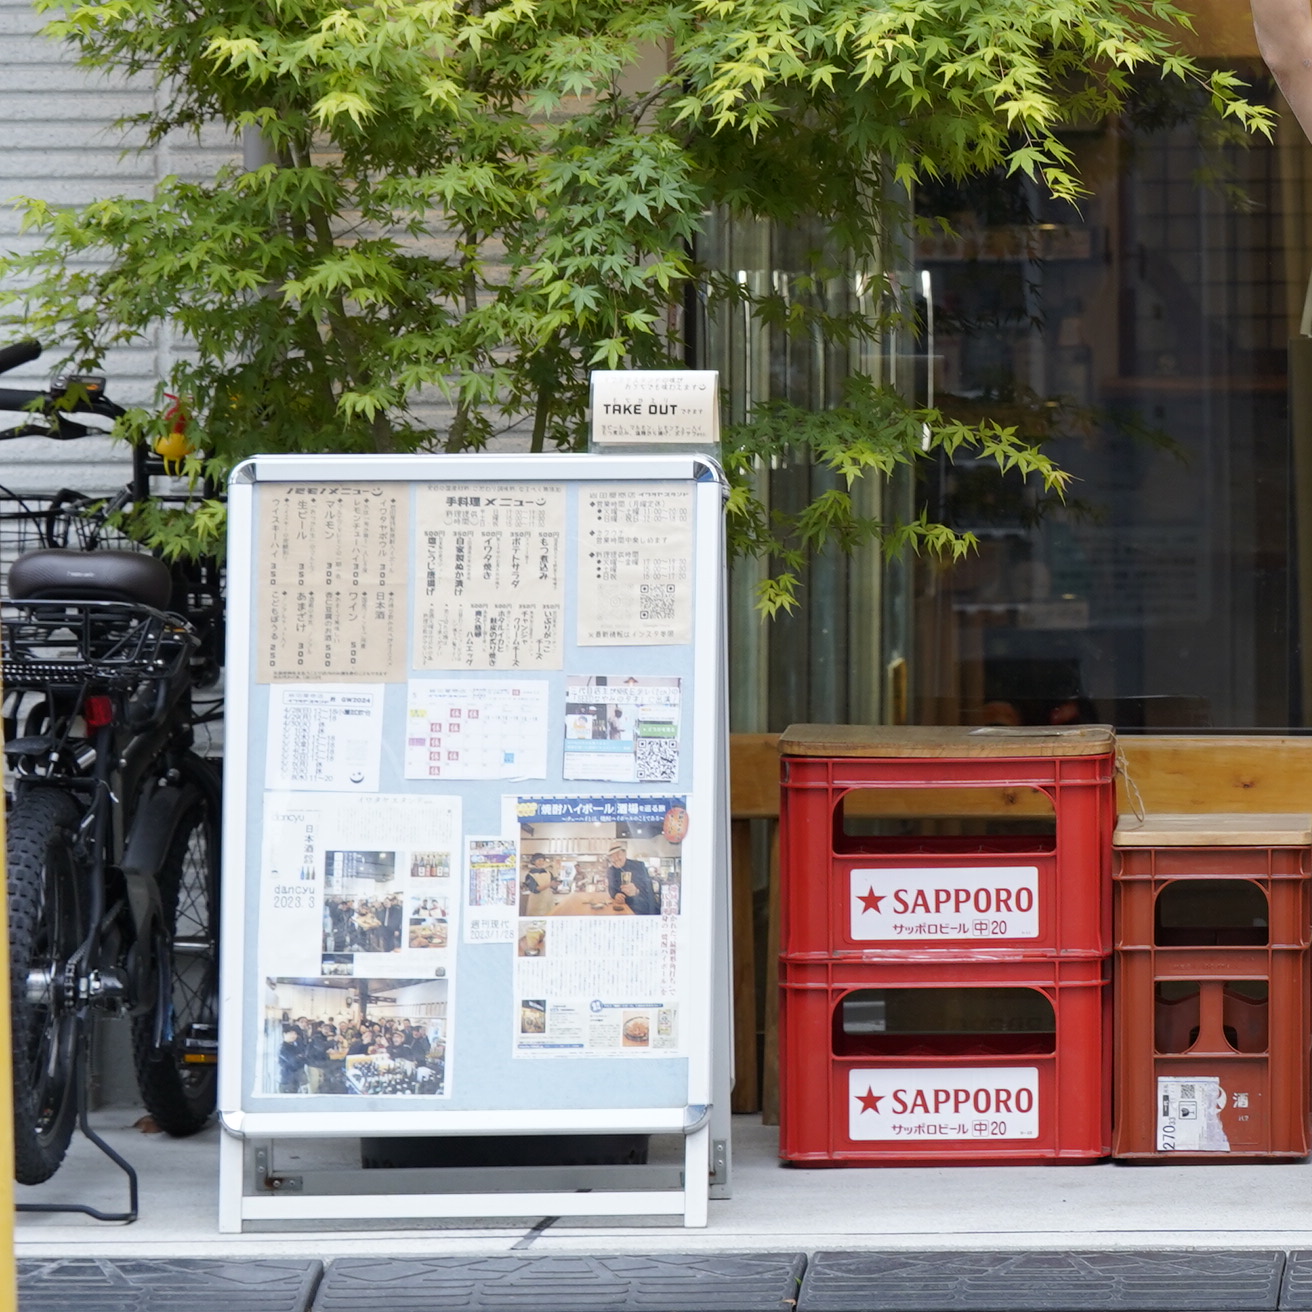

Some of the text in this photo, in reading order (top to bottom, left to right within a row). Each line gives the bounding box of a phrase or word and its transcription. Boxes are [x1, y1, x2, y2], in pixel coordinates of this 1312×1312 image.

[603, 404, 642, 415] TAKE
[648, 404, 678, 415] OUT
[270, 498, 281, 558] ウイスキーハイ
[296, 499, 308, 540] 生ビール
[325, 500, 336, 540] マルモン
[352, 499, 362, 561] レモンチューハイ
[510, 538, 521, 589] ポテトサラダ
[348, 592, 359, 622] ワイン
[374, 591, 386, 620] 日本酒
[273, 884, 316, 896] dancyu
[892, 886, 1034, 915] SAPPORO
[470, 919, 510, 929] 週刊現代
[892, 922, 970, 935] サッポロビール
[891, 1087, 1034, 1115] SAPPORO
[1232, 1092, 1249, 1108] 酒
[891, 1123, 970, 1135] サッポロビール
